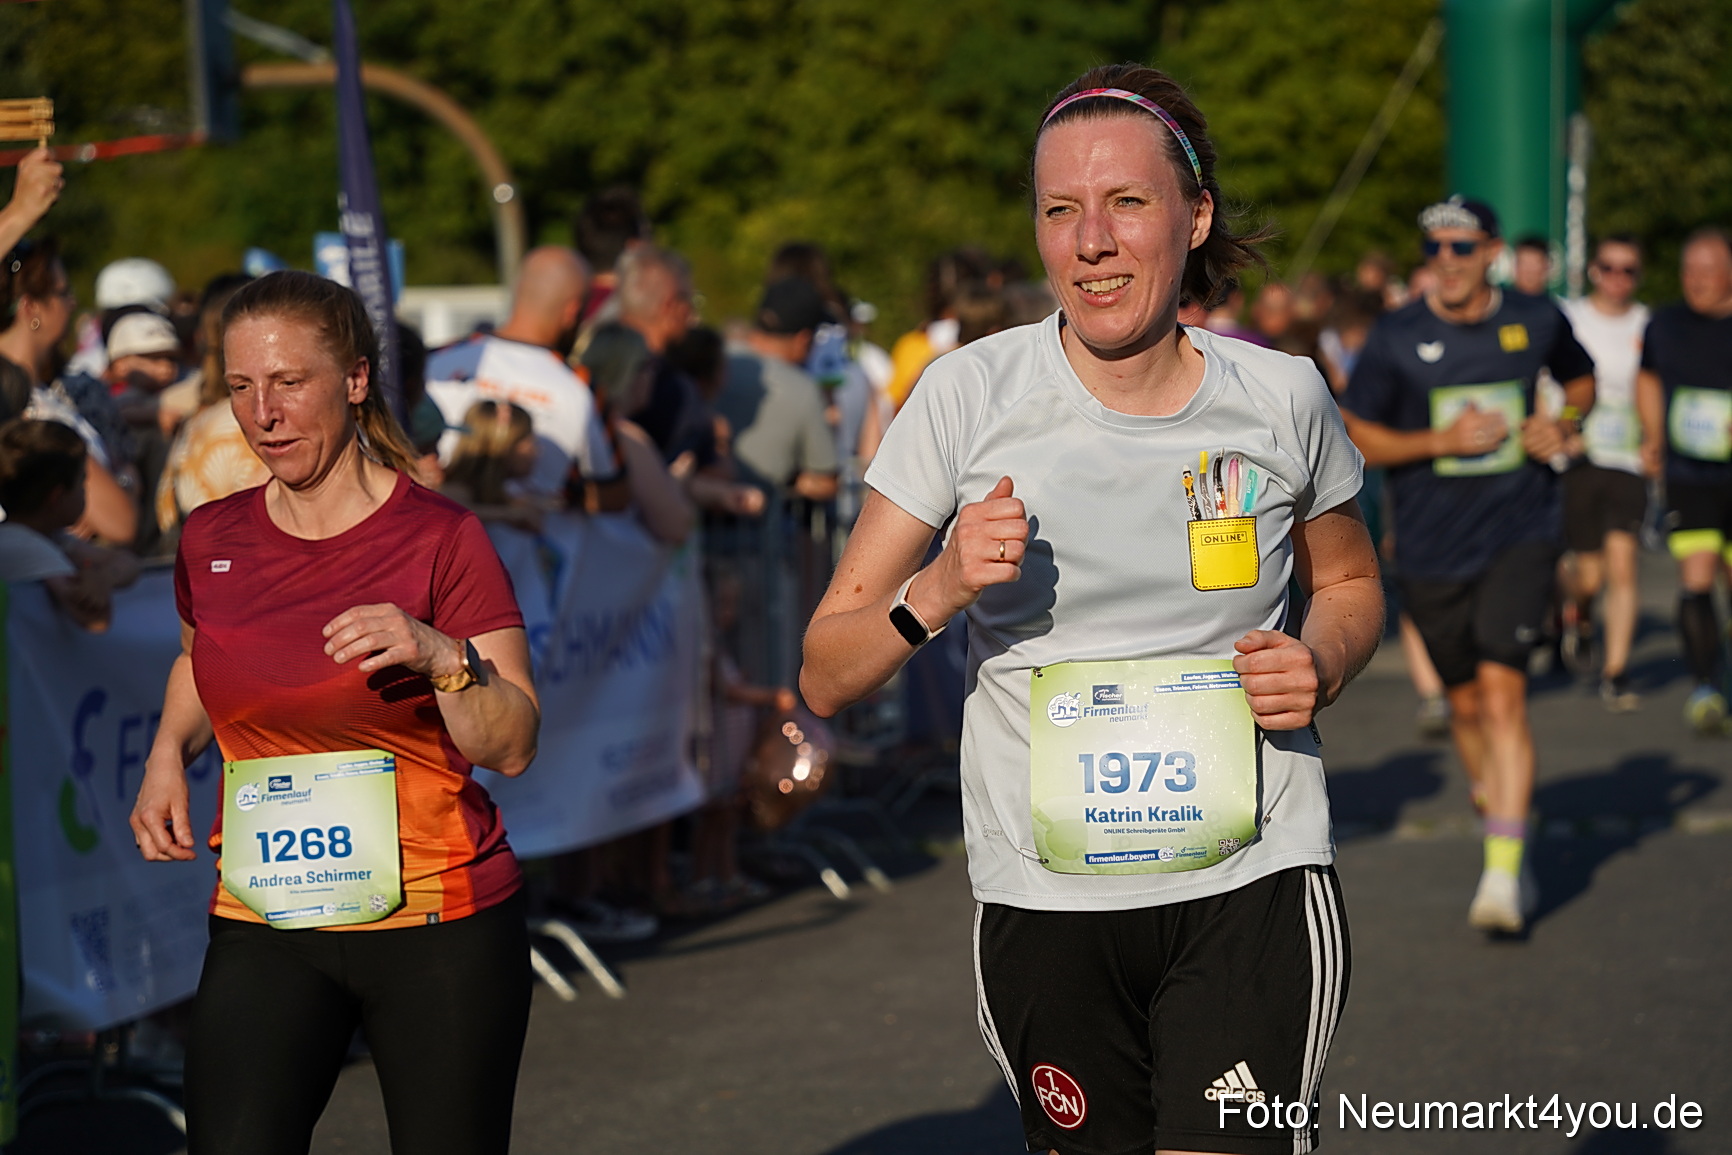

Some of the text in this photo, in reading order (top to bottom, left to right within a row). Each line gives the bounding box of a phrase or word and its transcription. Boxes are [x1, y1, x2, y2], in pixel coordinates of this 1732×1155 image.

[1083, 702, 1149, 718] Firmenlauf
[1109, 713, 1149, 723] neumarkt
[1078, 751, 1197, 794] 1973
[261, 787, 312, 803] Firmenlauf
[1085, 805, 1204, 824] Katrin Kralik
[1126, 827, 1167, 835] Schreibgeräte
[256, 825, 353, 864] 1268
[1088, 852, 1156, 864] firmenlauf.bayern
[249, 868, 373, 889] Andrea Schirmer
[1044, 1070, 1060, 1092] 1.
[1037, 1085, 1080, 1117] FCN
[1204, 1085, 1266, 1104] adidas
